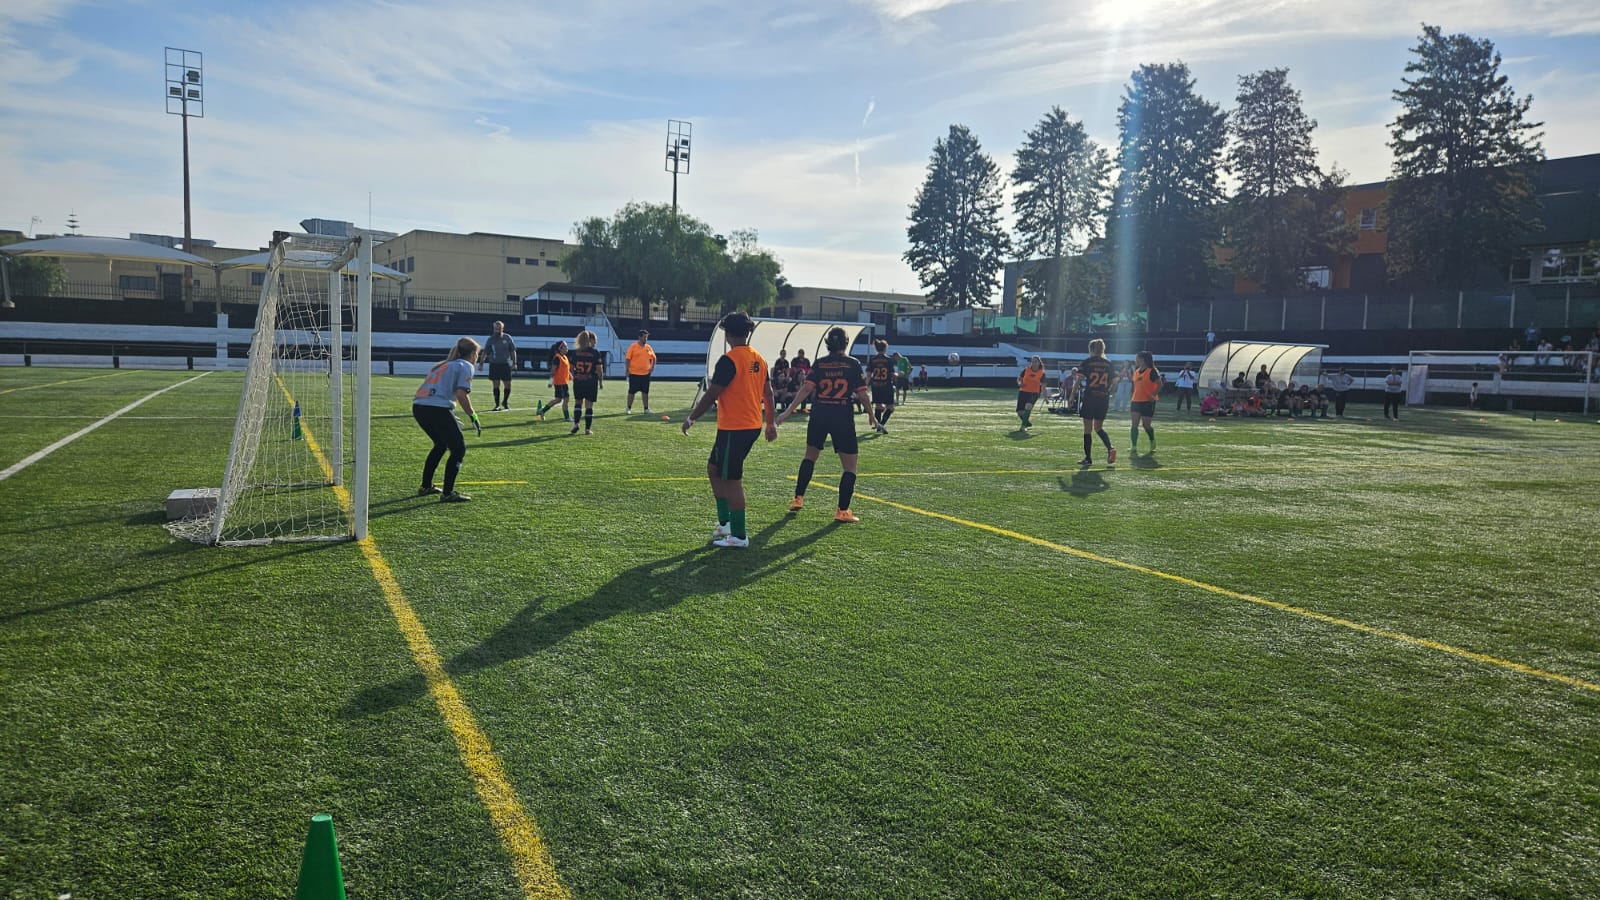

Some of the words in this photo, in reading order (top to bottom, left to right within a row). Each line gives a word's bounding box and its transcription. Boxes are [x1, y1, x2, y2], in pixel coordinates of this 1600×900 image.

[576, 361, 593, 374] 57
[874, 367, 888, 381] 23
[1089, 371, 1109, 388] 24
[818, 378, 848, 399] 22
